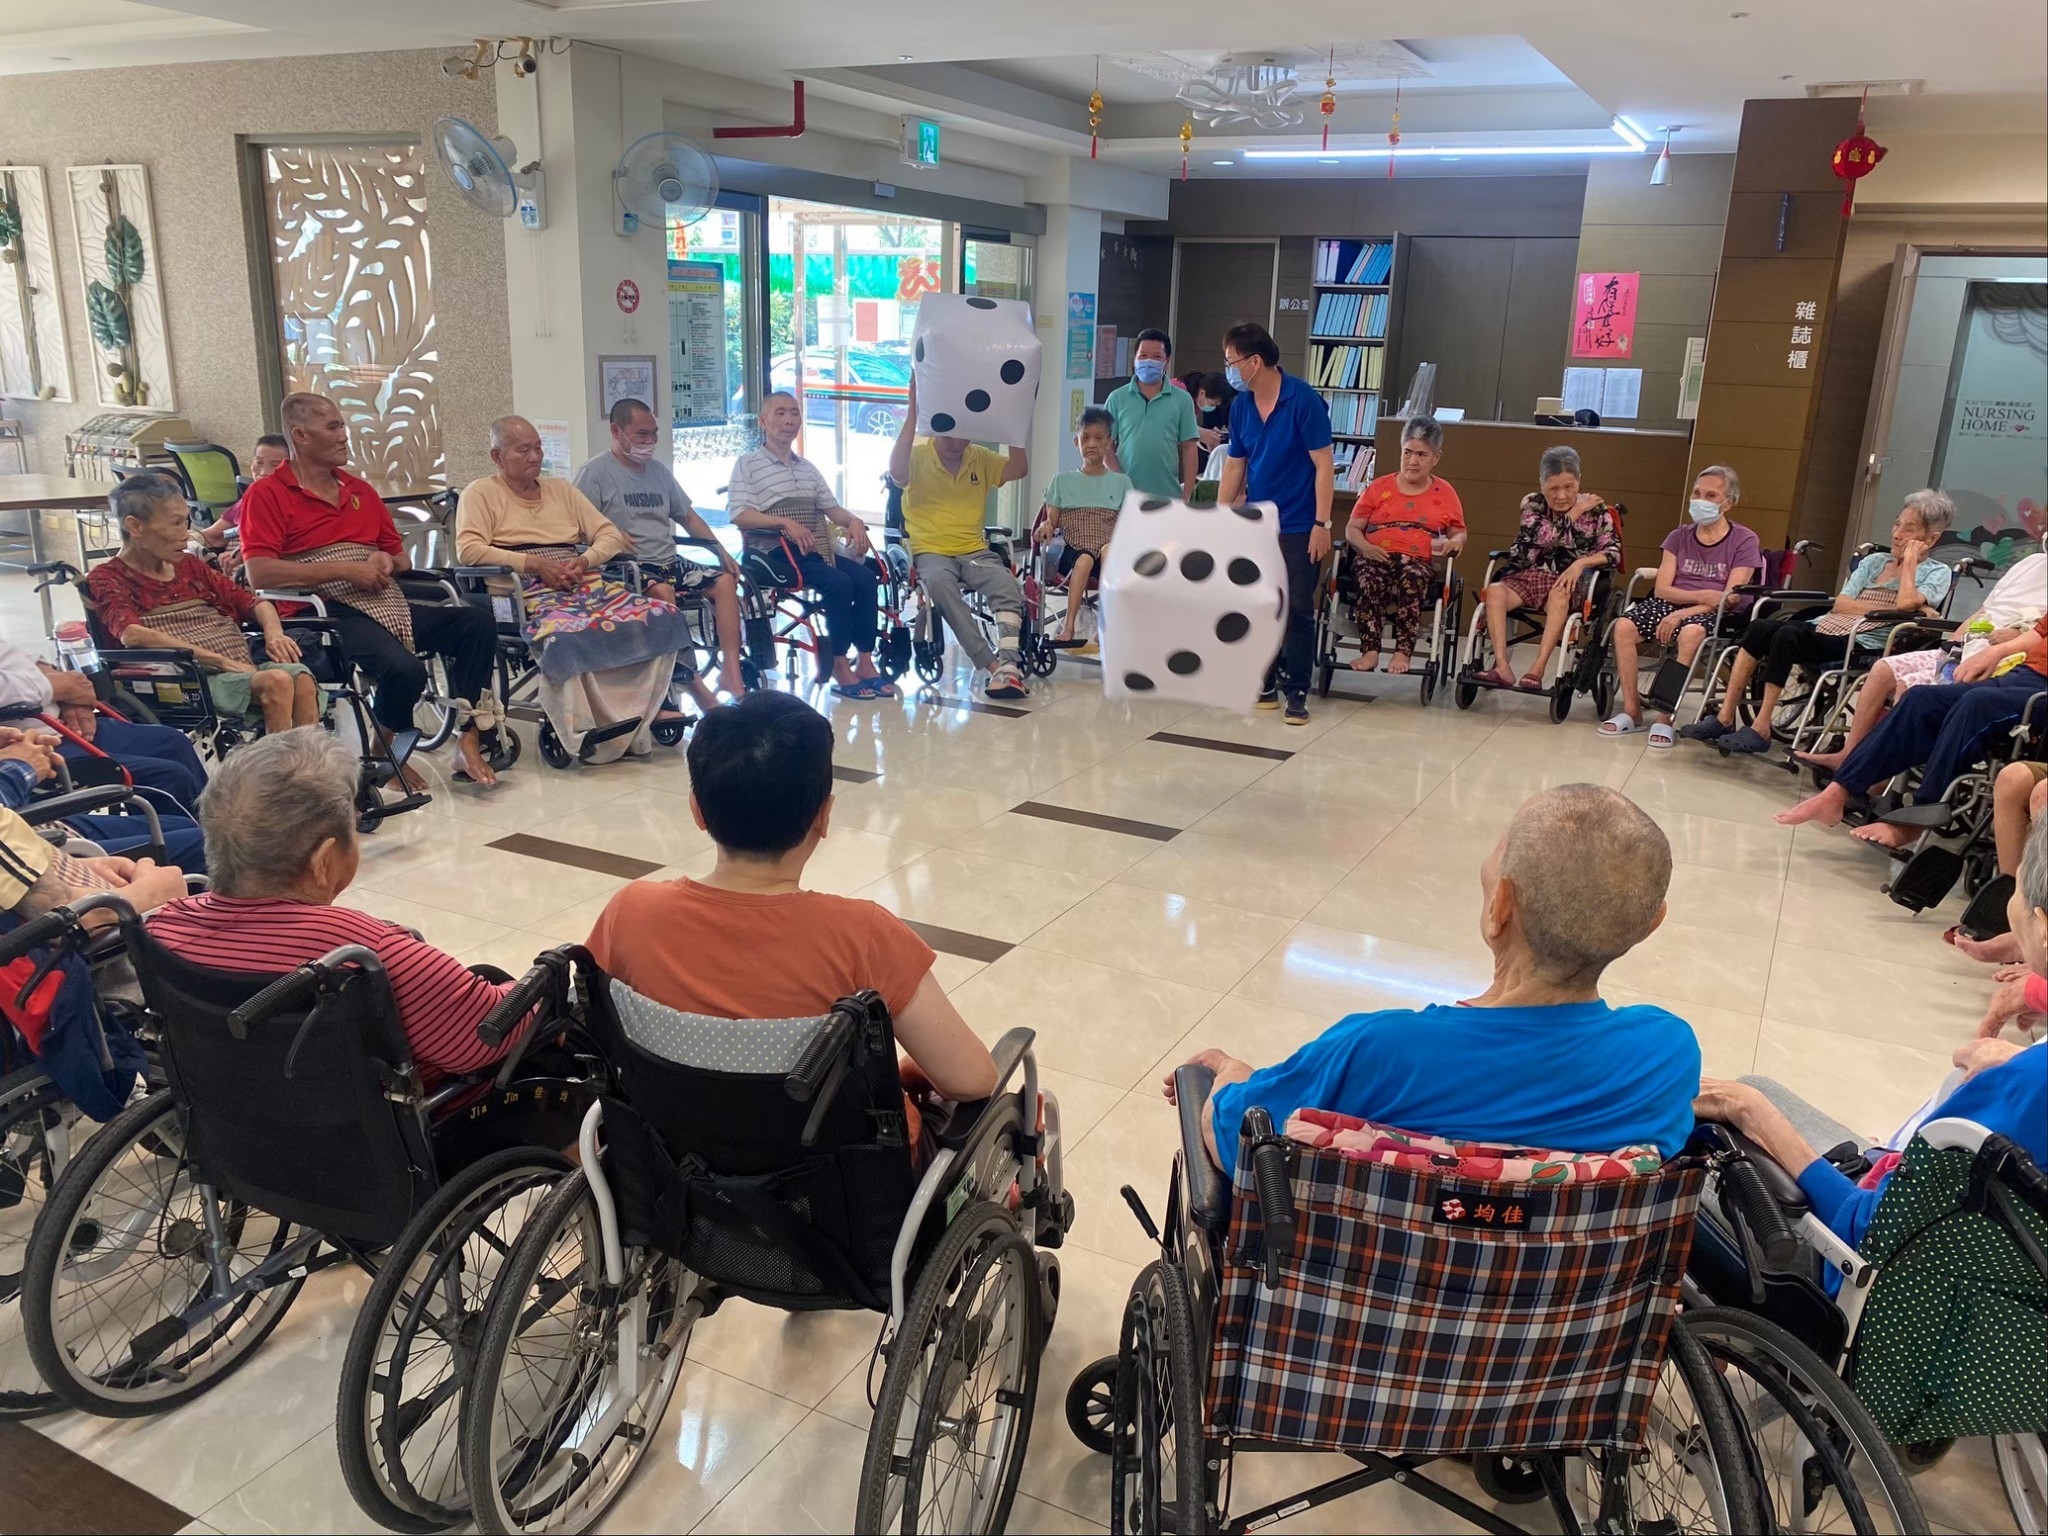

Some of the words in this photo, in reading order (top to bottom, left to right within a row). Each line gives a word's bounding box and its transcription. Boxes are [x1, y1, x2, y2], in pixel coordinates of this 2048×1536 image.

[1787, 301, 1817, 369] 雜誌櫃
[1963, 406, 2035, 421] NURSING
[1960, 418, 2008, 432] HOME
[1473, 1204, 1524, 1224] 均佳
